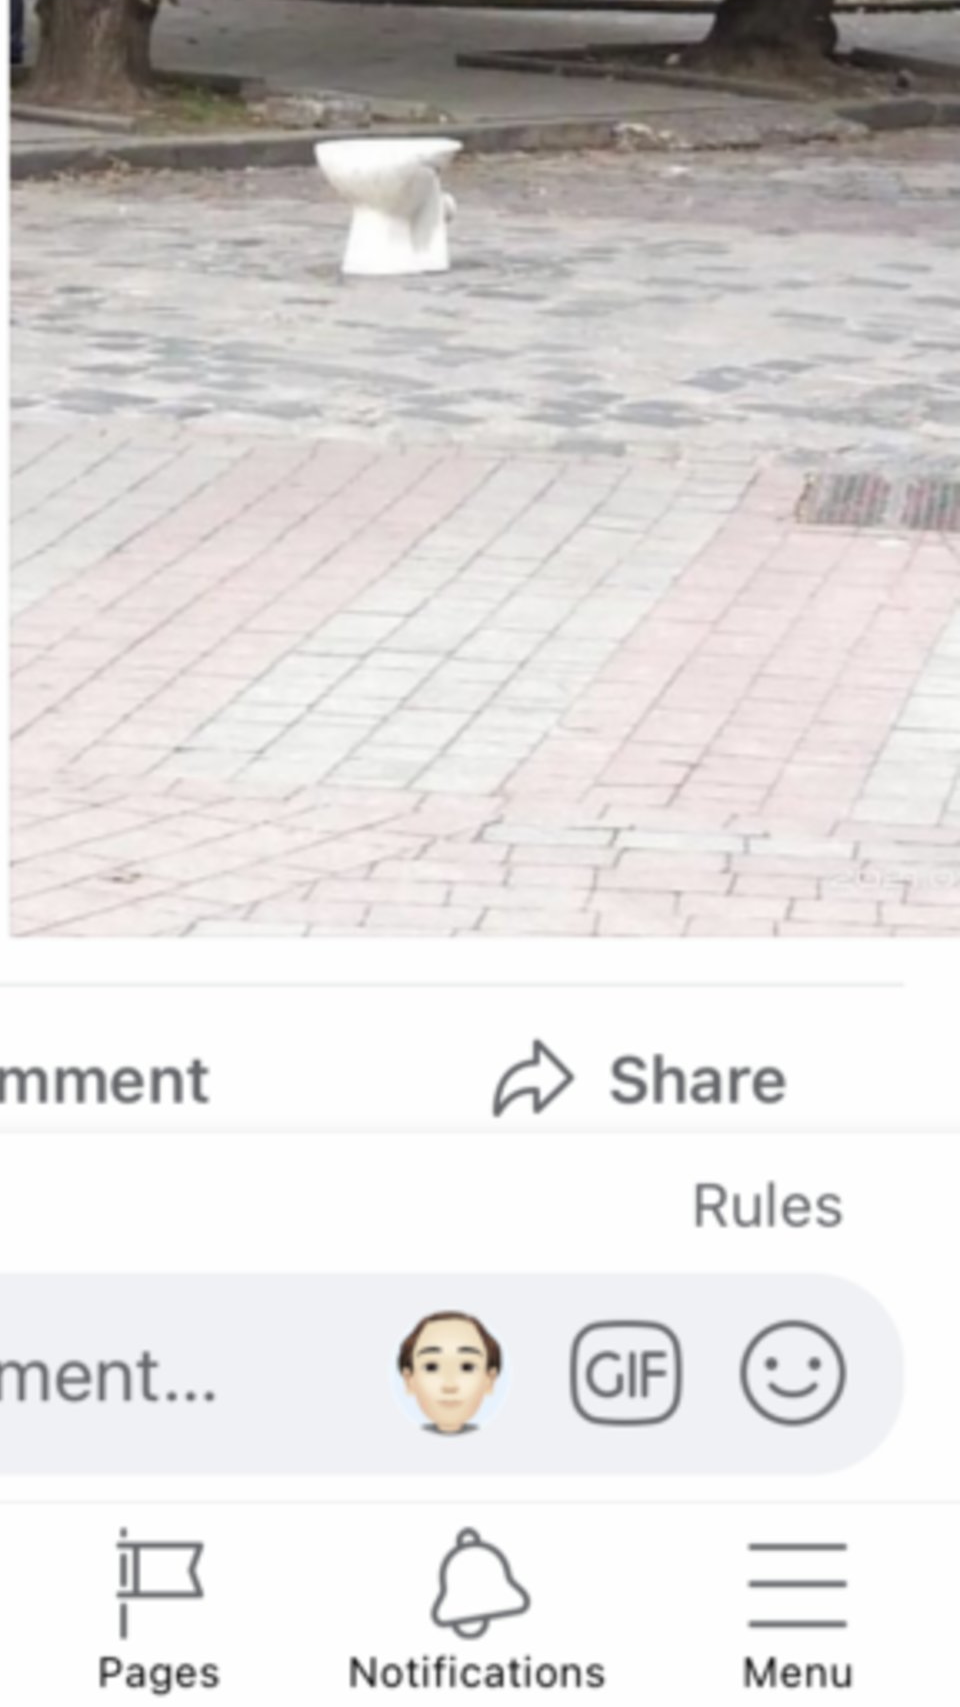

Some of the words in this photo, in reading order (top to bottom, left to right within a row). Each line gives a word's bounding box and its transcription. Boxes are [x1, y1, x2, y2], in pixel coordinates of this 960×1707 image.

[611, 1054, 786, 1104] Share
[696, 1182, 842, 1227] Rules
[586, 1350, 667, 1398] GIF
[99, 1656, 220, 1697] Pages
[350, 1655, 605, 1688] Notifications
[744, 1656, 852, 1688] Menu
